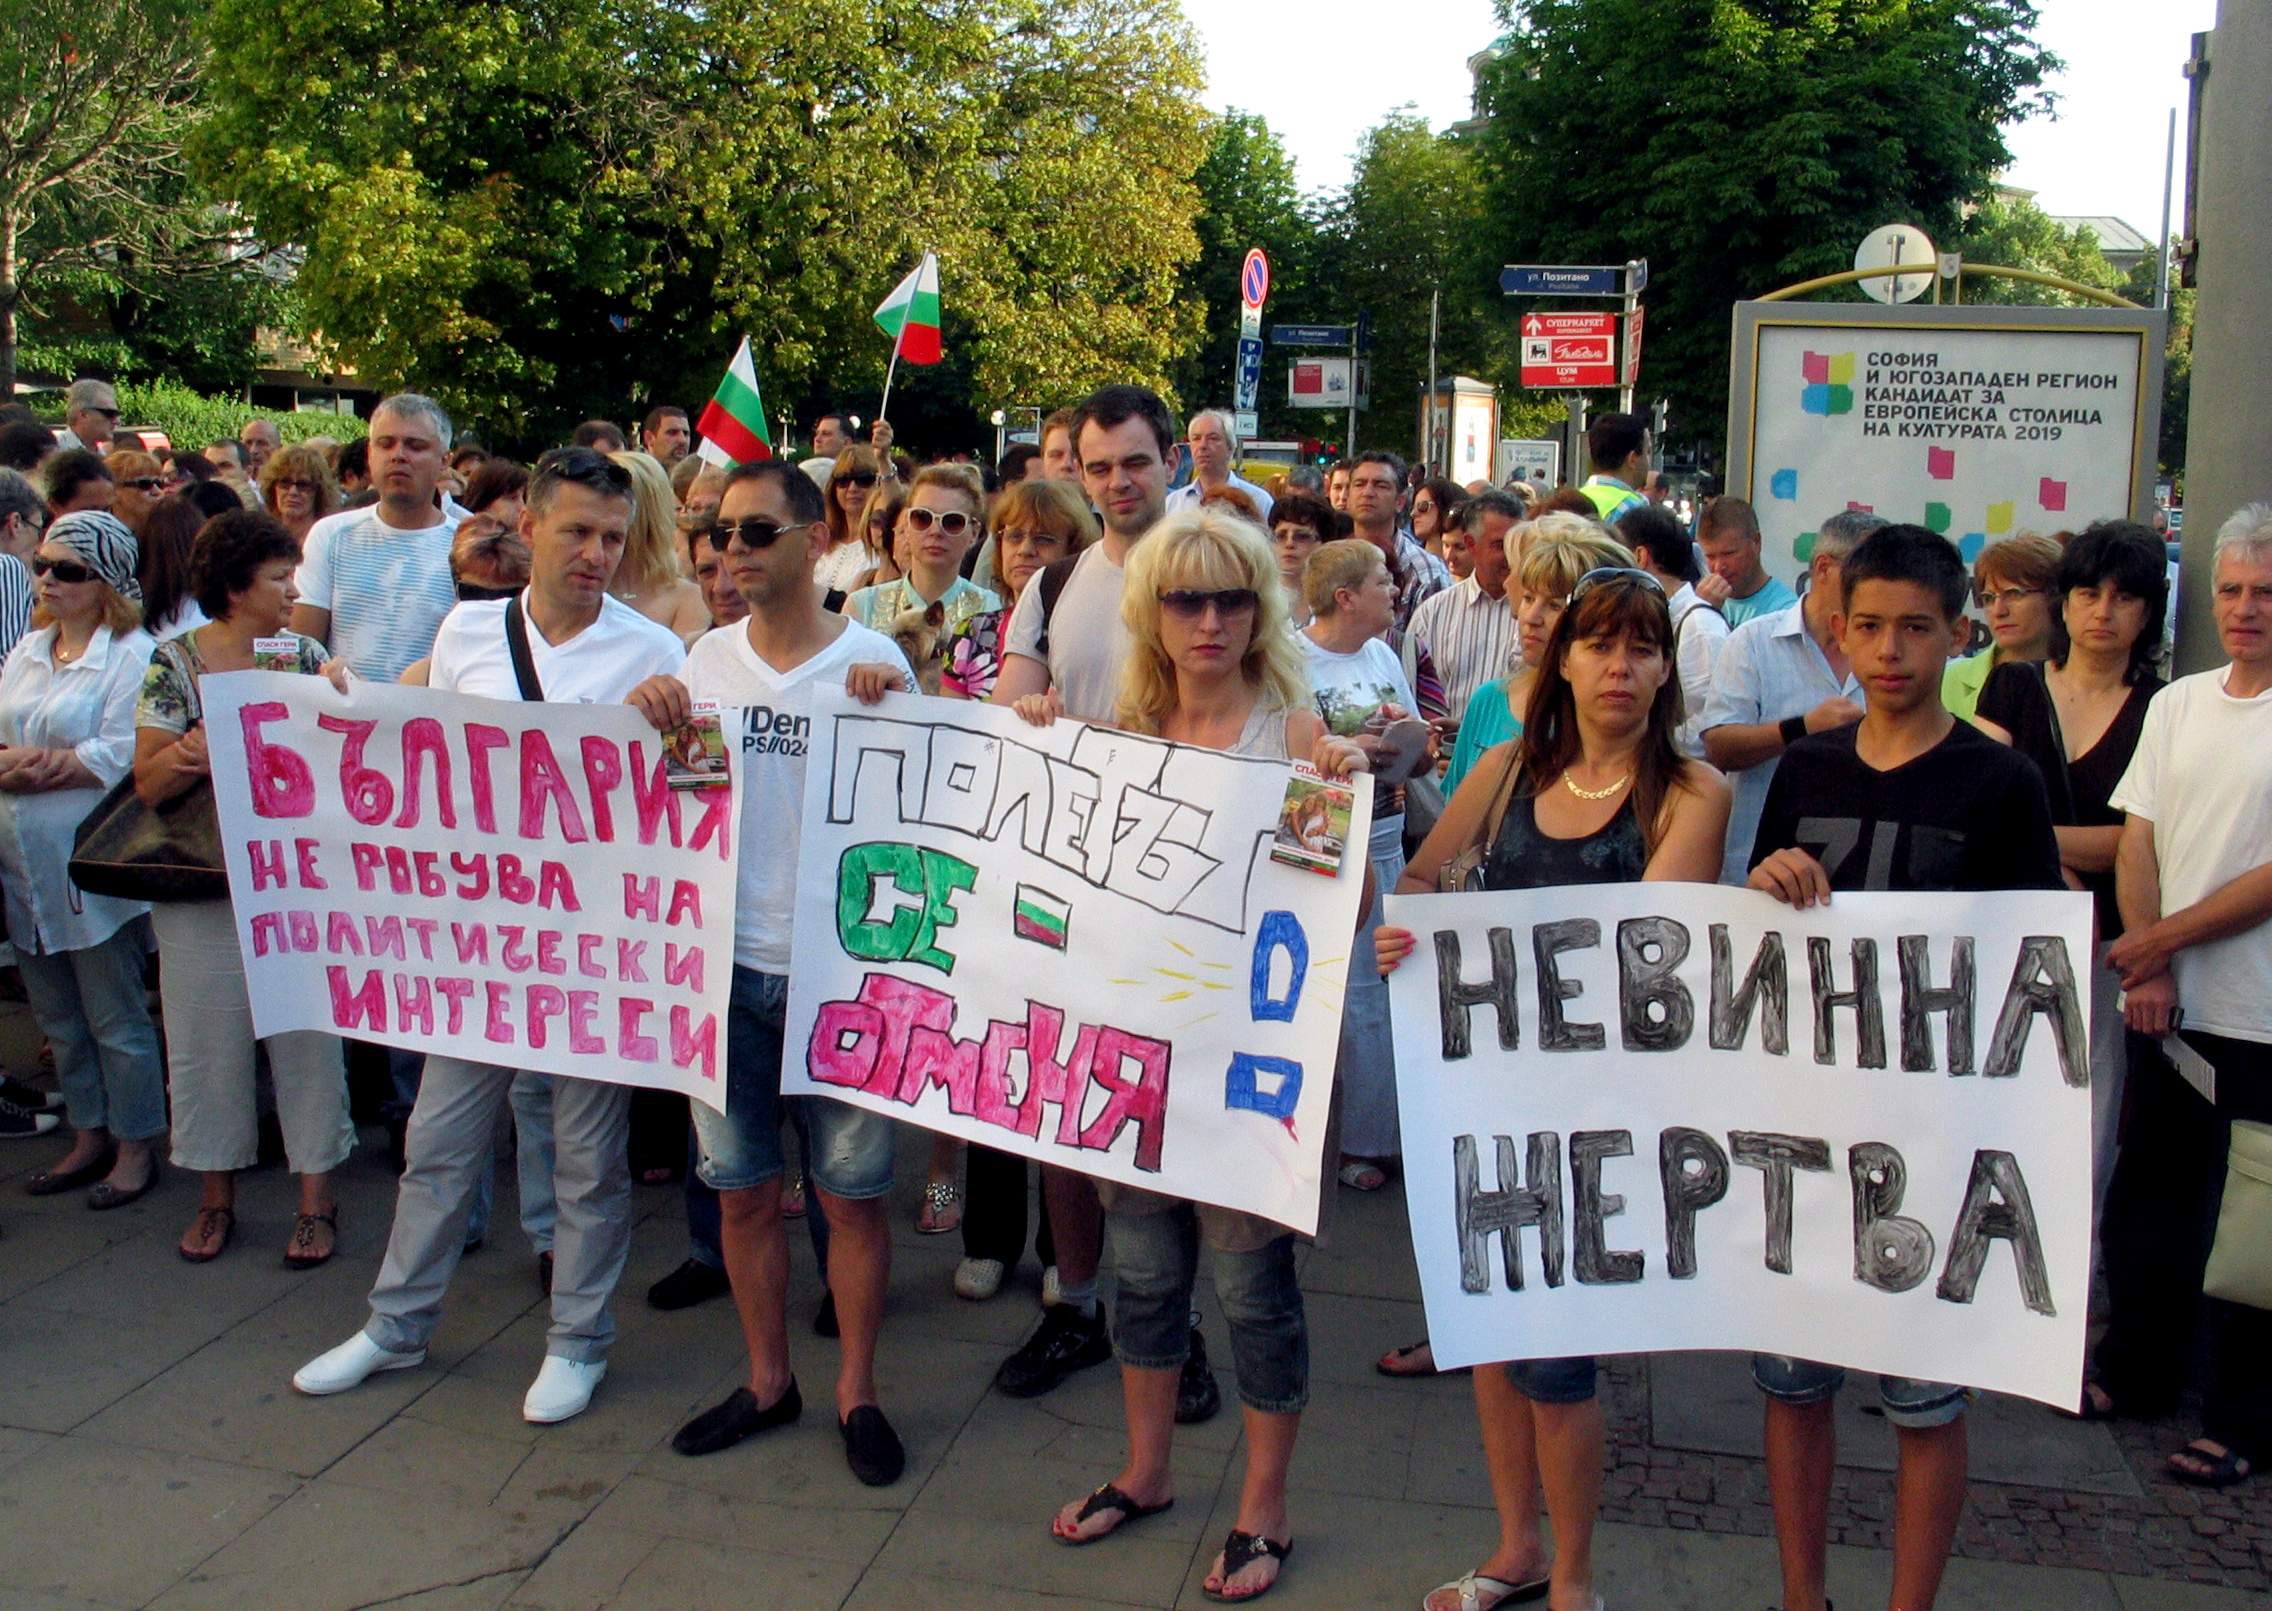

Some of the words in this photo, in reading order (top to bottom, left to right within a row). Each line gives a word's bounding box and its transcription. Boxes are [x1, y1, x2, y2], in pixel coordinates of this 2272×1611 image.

[1542, 272, 1590, 282] Позитано
[1546, 318, 1605, 328] СУПЕРМАРКЕТ
[1867, 352, 1938, 368] СОФИЯ
[1556, 367, 1578, 376] ЦУМ
[1866, 370, 1880, 384] И
[1889, 371, 2029, 389] ЮГОЗАПАДЕН
[2036, 373, 2118, 389] РЕГИОН
[1865, 387, 1973, 405] КАНДИДАТ
[1980, 389, 2006, 405] ЗА
[1864, 403, 1998, 422] ЕВРОПЕЙСКА
[2009, 408, 2103, 425] СТОЛИЦА
[1863, 422, 1891, 437] НА
[1898, 423, 2007, 440] КУЛТУРАТА
[2014, 426, 2063, 441] 2019
[693, 702, 717, 710] ГЕРИ
[239, 702, 731, 861] БЪЛГАРИЯ
[247, 838, 328, 893] НЕ
[350, 842, 582, 912] РОБУВА
[623, 873, 703, 930] НА
[836, 841, 980, 976] СЕ
[250, 911, 705, 994] ПОЛИТИЧЕСКИ
[1432, 915, 2090, 1088] НЕВИННА
[325, 965, 717, 1082] ИНТЕРЕСИ
[806, 972, 1173, 1173] ОТМЕНЯ
[1452, 1126, 2058, 1318] ЖЕРТВА
